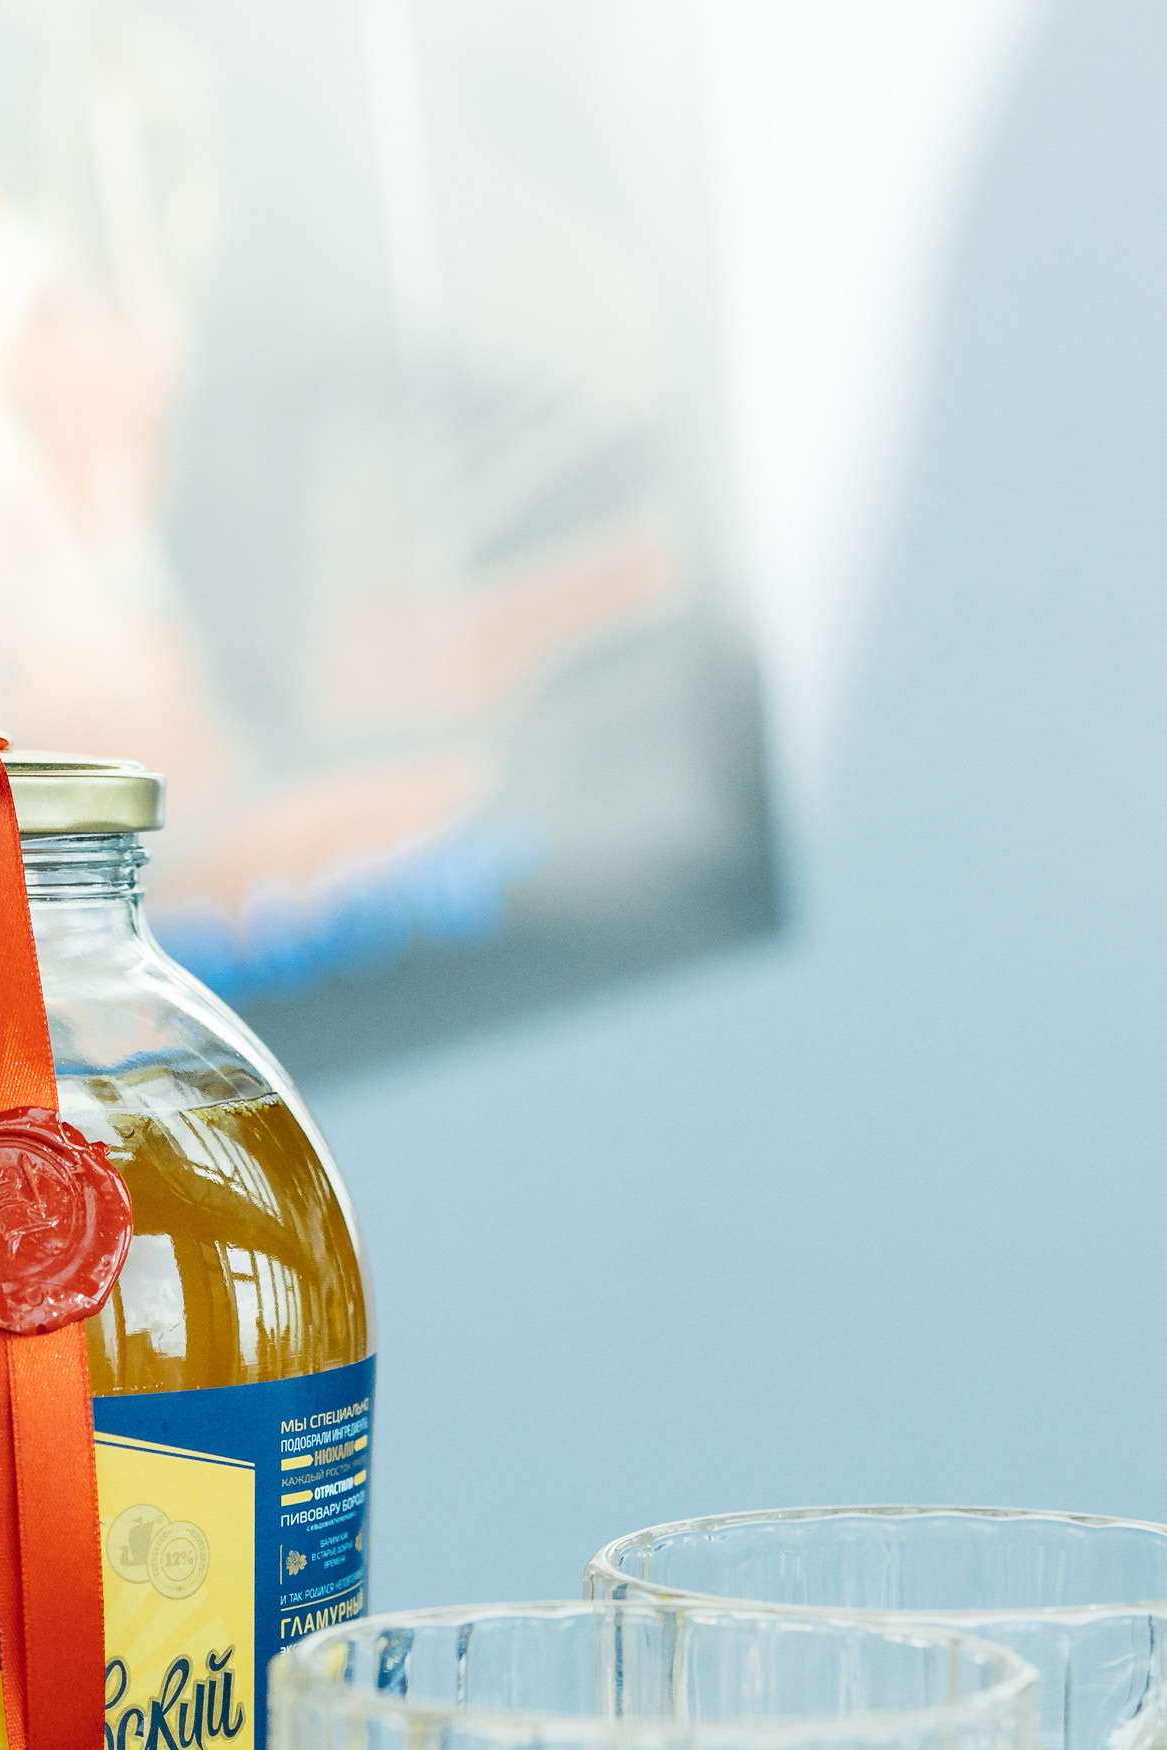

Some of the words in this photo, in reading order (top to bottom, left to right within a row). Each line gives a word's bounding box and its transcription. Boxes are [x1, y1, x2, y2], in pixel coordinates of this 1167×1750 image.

[280, 1417, 307, 1435] МЫ
[280, 1430, 332, 1454] ПОДОБРАЛИ
[314, 1440, 354, 1466] НЮХАЛИ
[281, 1469, 324, 1488] КАЖДЫЙ
[281, 1503, 341, 1528] ПИВОВАРУ
[164, 1551, 195, 1567] 12%
[280, 1595, 286, 1605] И
[289, 1592, 303, 1603] ТАК
